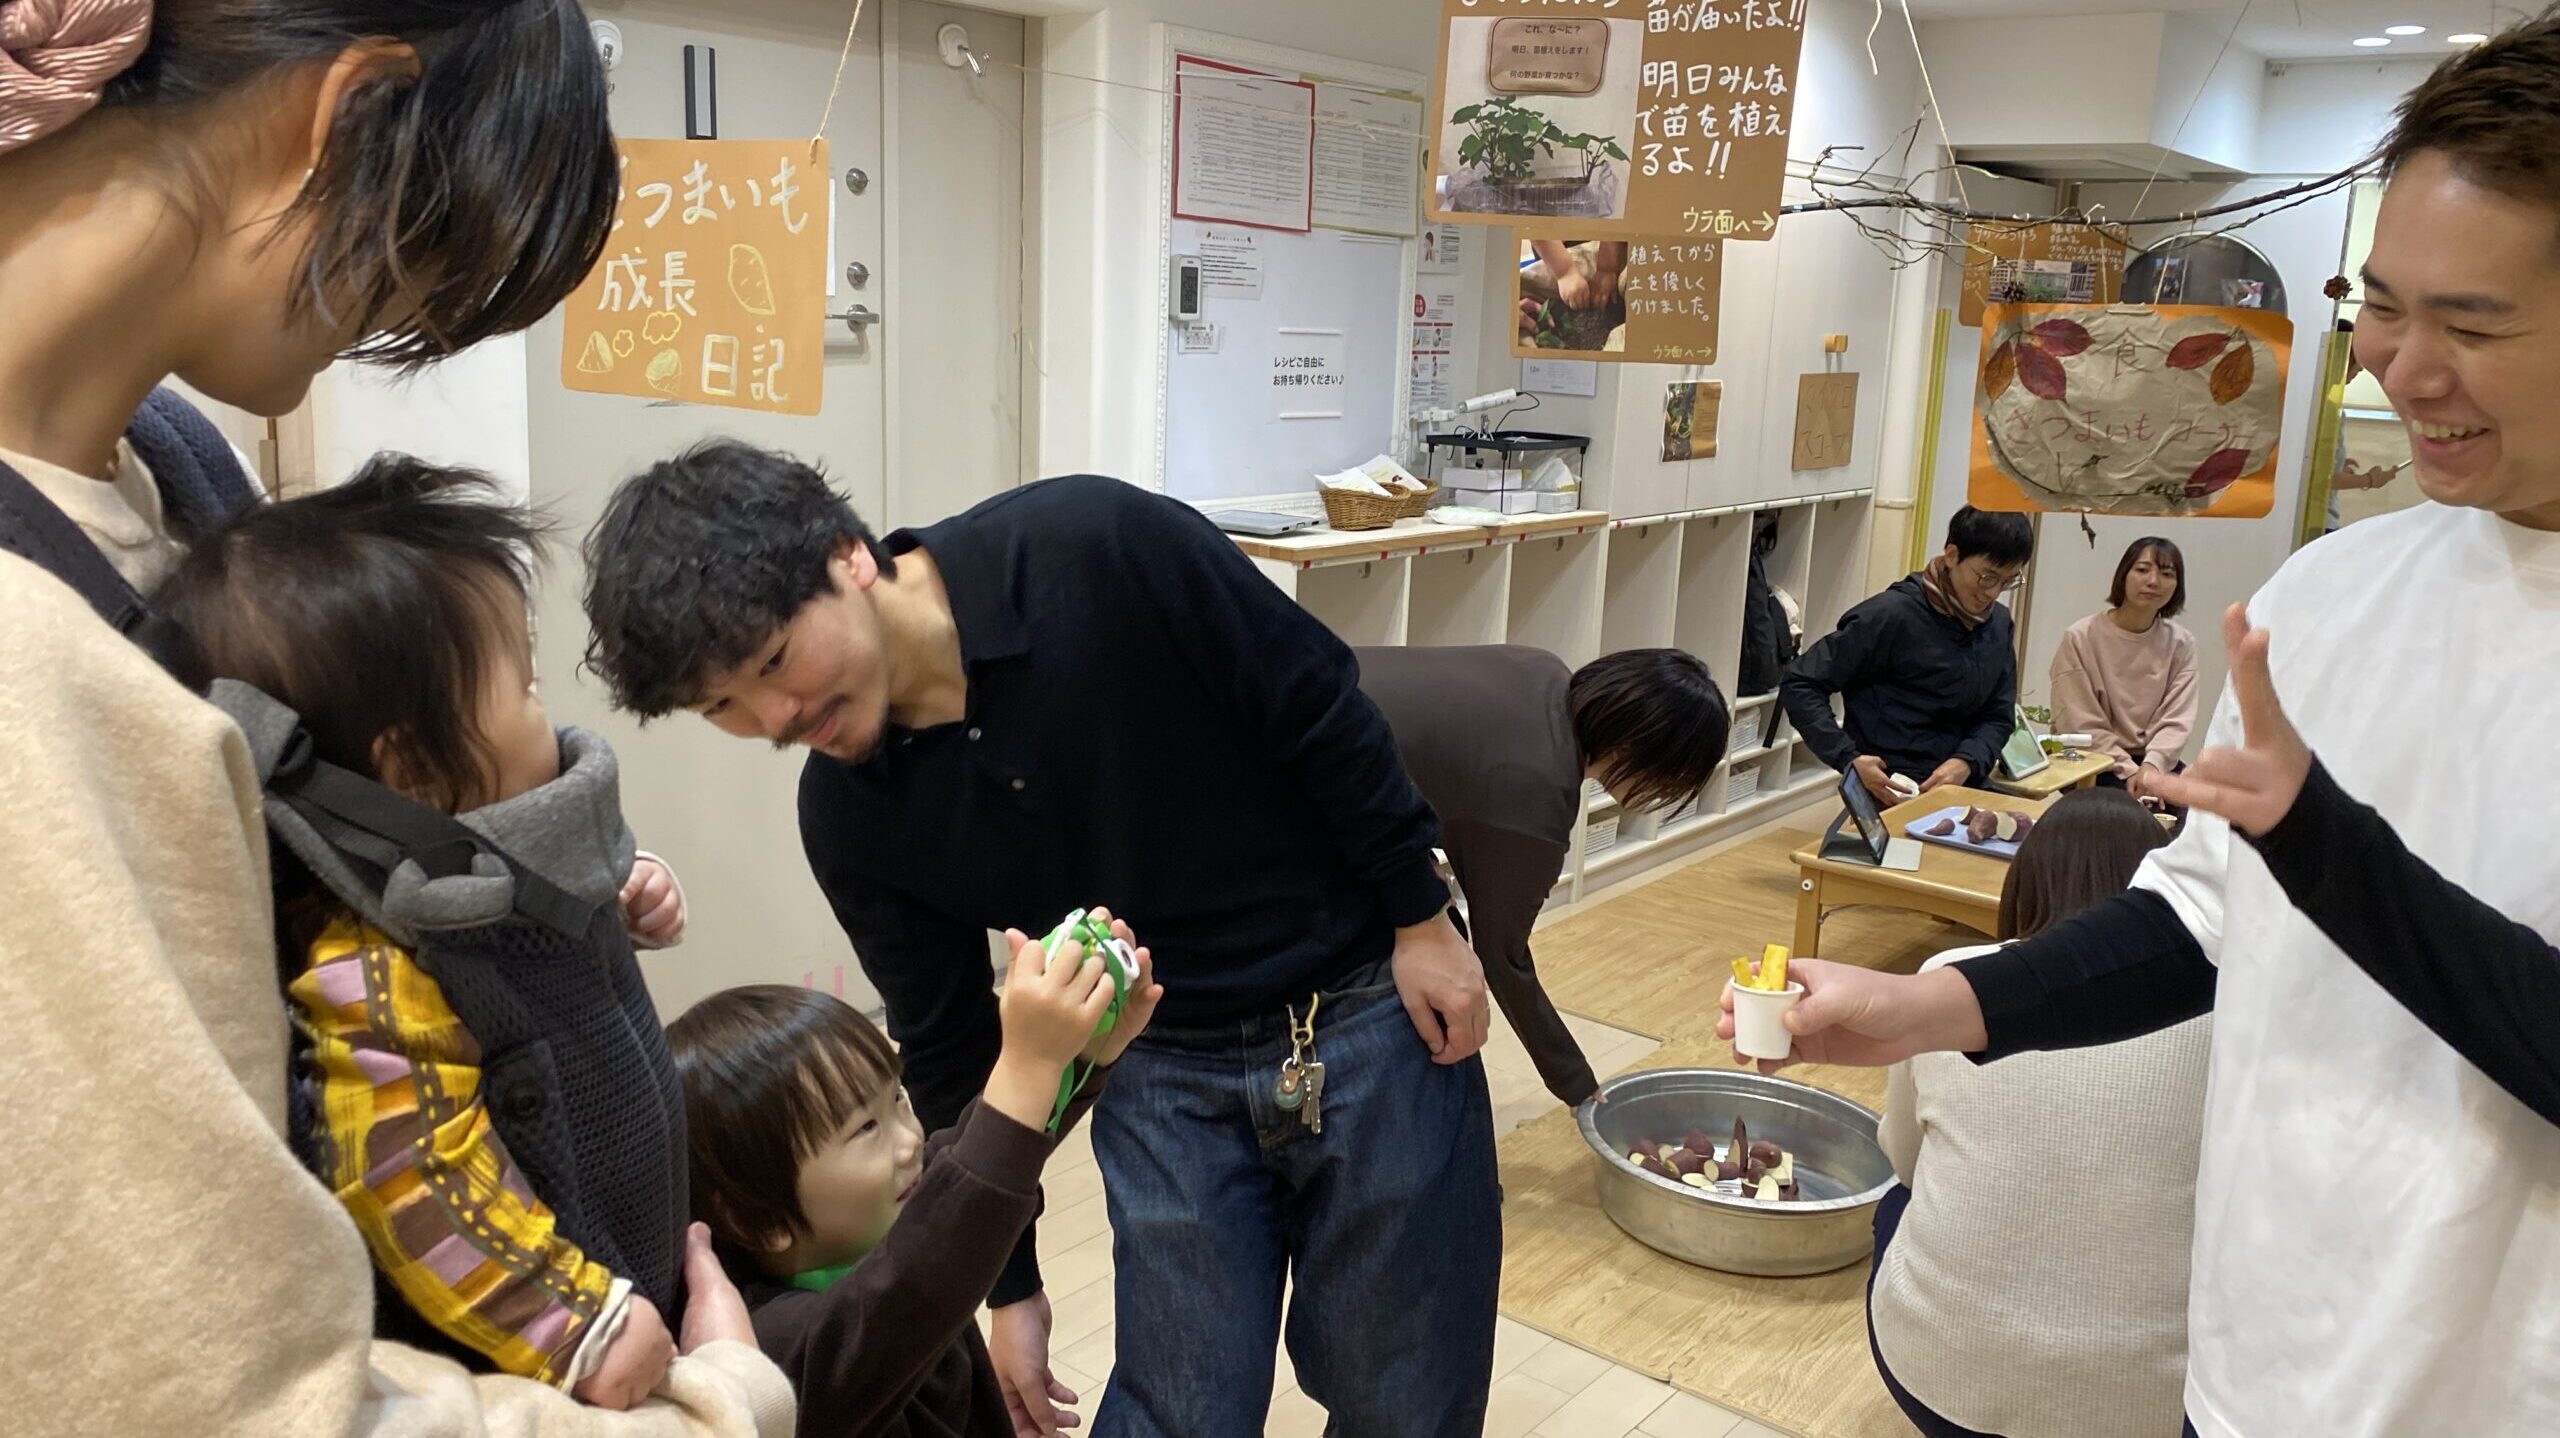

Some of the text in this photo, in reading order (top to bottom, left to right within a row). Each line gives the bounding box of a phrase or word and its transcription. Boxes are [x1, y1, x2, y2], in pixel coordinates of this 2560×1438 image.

[1642, 60, 1788, 98] 明日みんな
[1636, 101, 1787, 138] で苗を植え
[1629, 243, 1717, 265] 植えてから
[597, 247, 697, 316] 成長
[1628, 271, 1706, 292] 土を優しく
[1629, 295, 1711, 321] かけました。
[702, 324, 790, 404] 日記
[1273, 357, 1325, 369] レシピご自由に
